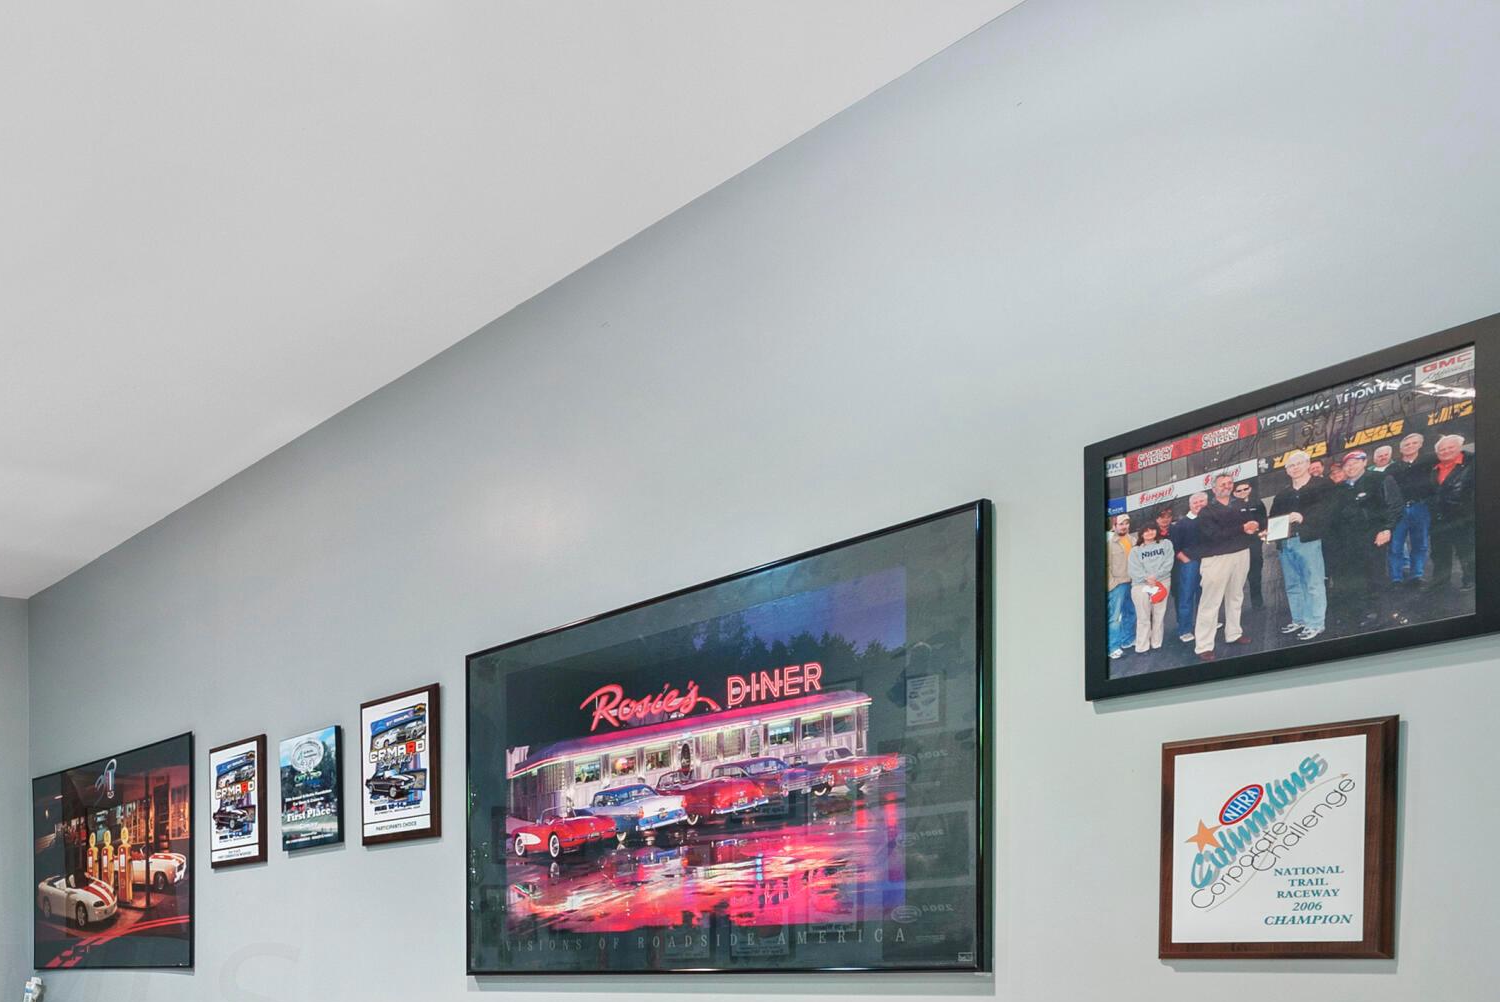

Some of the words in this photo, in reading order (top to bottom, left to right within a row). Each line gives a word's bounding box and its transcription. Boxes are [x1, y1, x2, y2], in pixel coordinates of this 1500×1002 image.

[1423, 352, 1472, 373] GMC
[727, 662, 823, 706] DINER
[580, 679, 721, 732] Rosie's
[369, 739, 426, 763] CAMARO
[215, 779, 255, 800] CAMARO
[287, 811, 306, 822] First
[307, 807, 331, 819] Place
[1225, 786, 1259, 821] NHRA
[1191, 754, 1329, 890] Columbus
[1250, 777, 1356, 872] Challenge
[1190, 821, 1288, 909] Corporate
[1274, 866, 1345, 877] NATIONAL
[1276, 888, 1341, 899] RACEWAY
[1288, 878, 1329, 887] TRAIL
[1292, 902, 1323, 912] 2006
[1263, 913, 1354, 926] CHAMPION
[505, 938, 582, 952] VISIONS
[598, 937, 620, 951] OF
[637, 934, 755, 949] ROADSIDE
[778, 927, 906, 946] AMERICA
